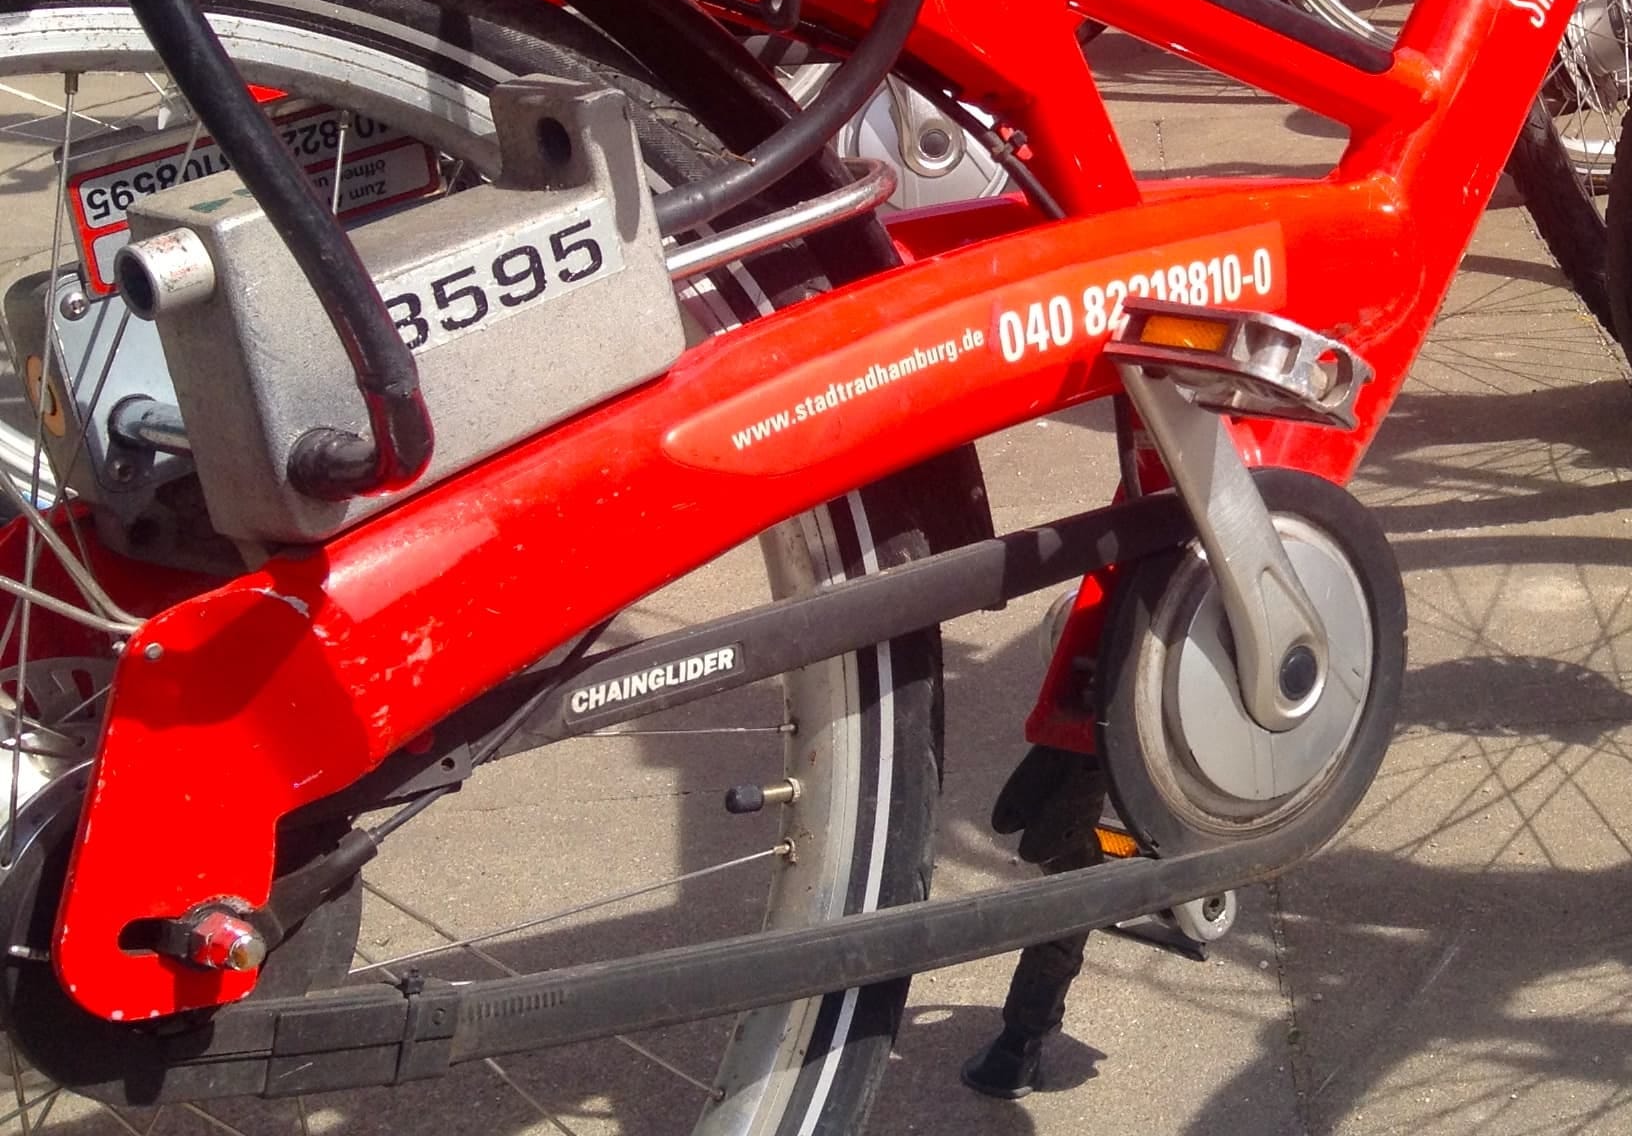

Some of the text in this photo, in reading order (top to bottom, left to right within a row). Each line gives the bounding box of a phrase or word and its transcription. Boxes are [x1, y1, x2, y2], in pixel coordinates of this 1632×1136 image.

[731, 328, 985, 451] www.stadtradhamburg.de
[999, 295, 1074, 363] 040
[570, 648, 735, 714] CHAINGLIDER
